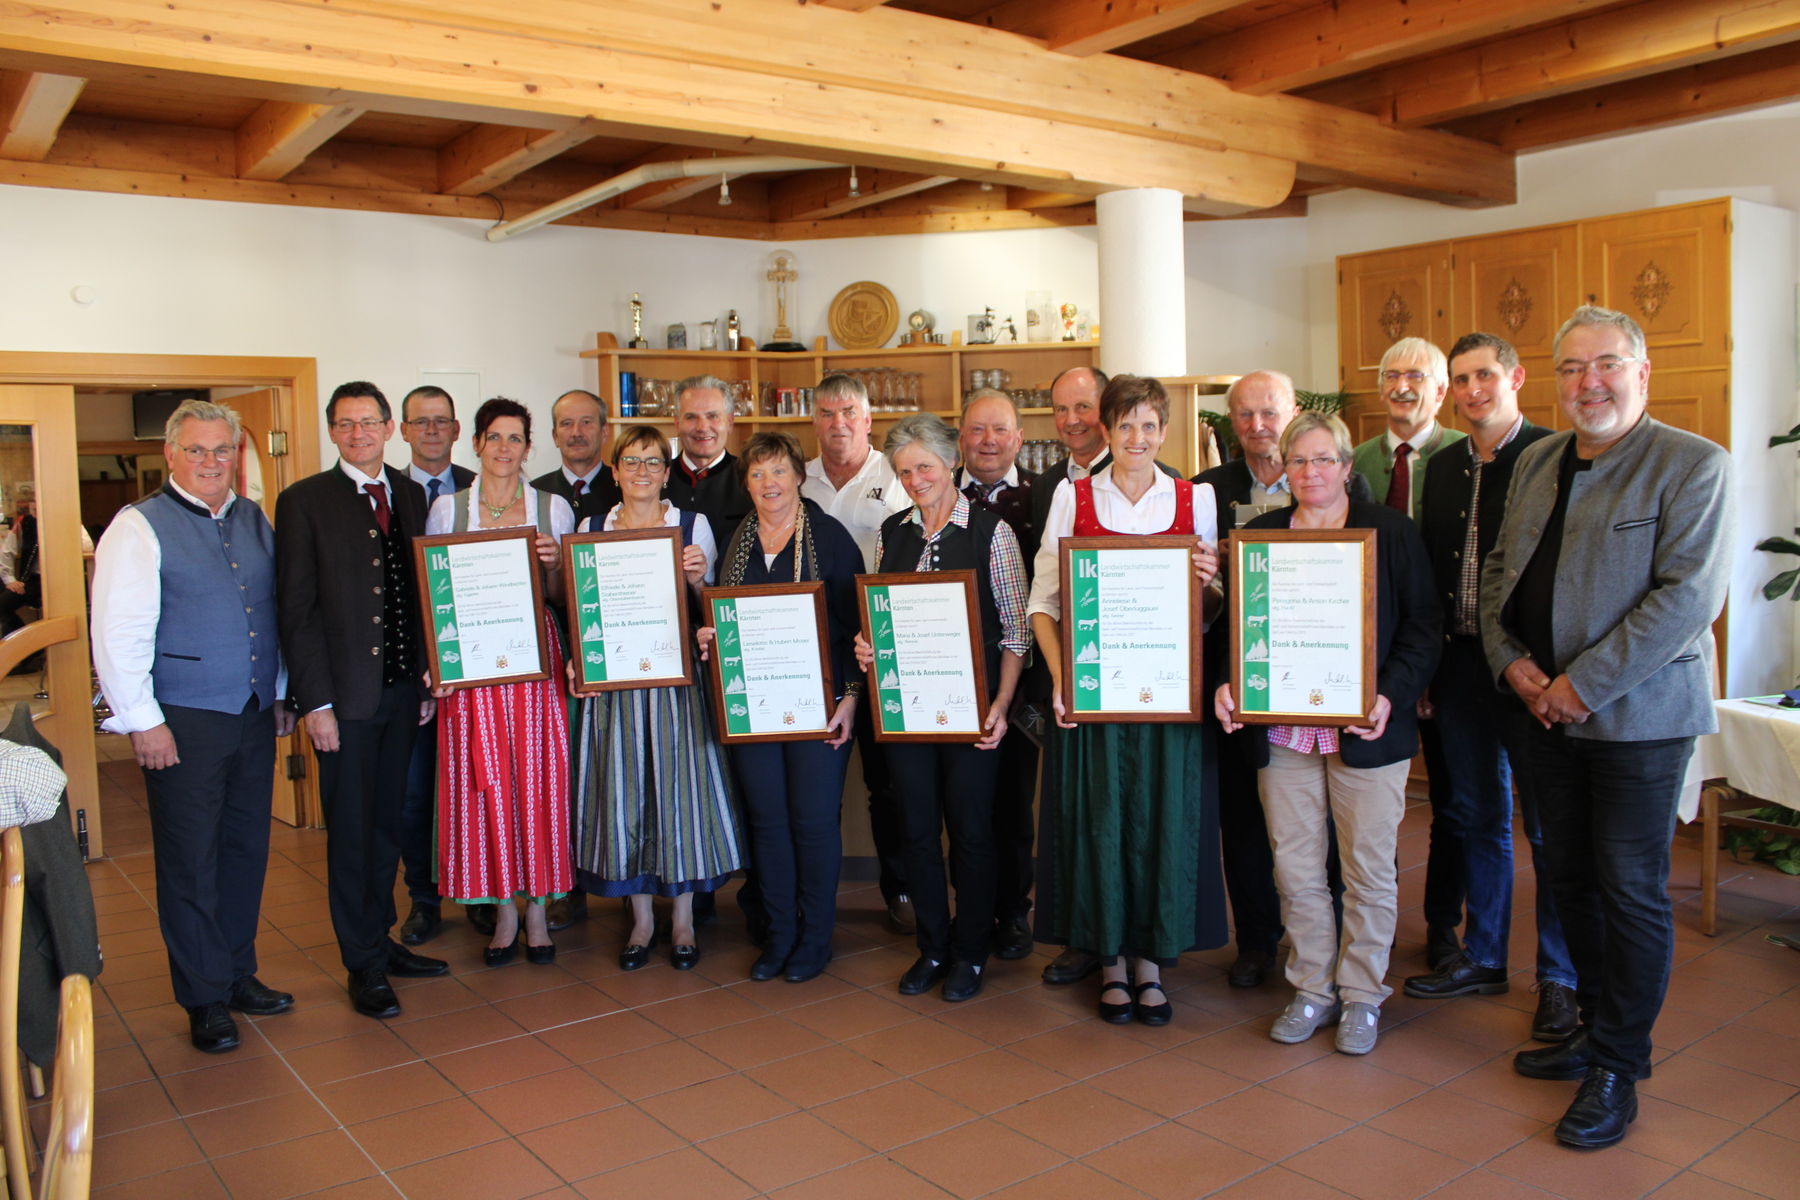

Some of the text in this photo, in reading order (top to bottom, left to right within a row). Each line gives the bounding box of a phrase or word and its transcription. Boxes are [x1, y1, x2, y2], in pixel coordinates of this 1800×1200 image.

[1130, 642, 1176, 650] Anerkennung
[1272, 640, 1290, 648] Dank
[1300, 641, 1349, 650] Anerkennung
